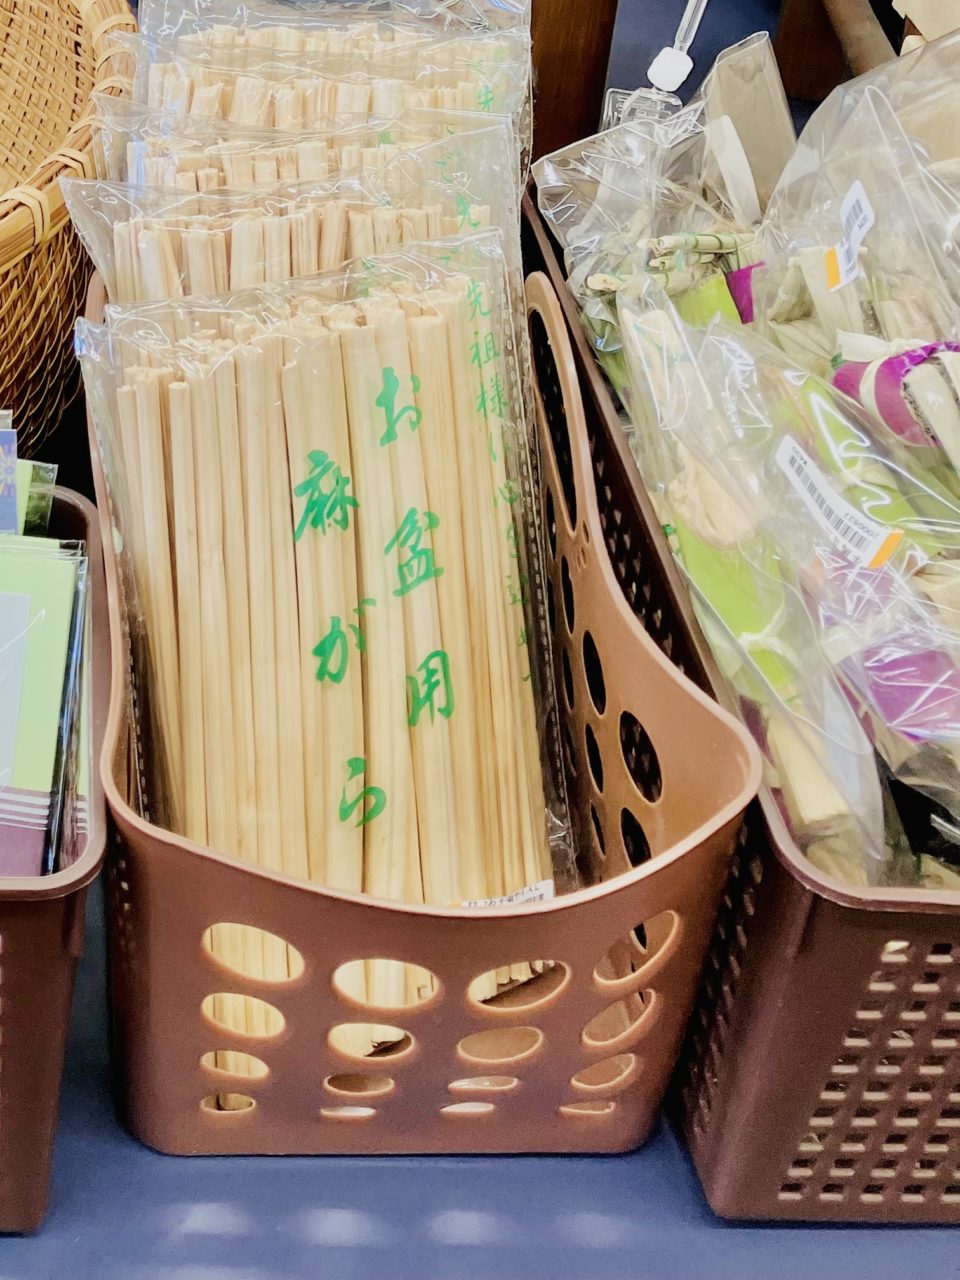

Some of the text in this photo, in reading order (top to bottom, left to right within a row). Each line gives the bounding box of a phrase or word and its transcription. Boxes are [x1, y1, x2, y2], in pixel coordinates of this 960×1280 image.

[293, 449, 387, 828] 麻がら
[375, 366, 455, 728] お盆用
